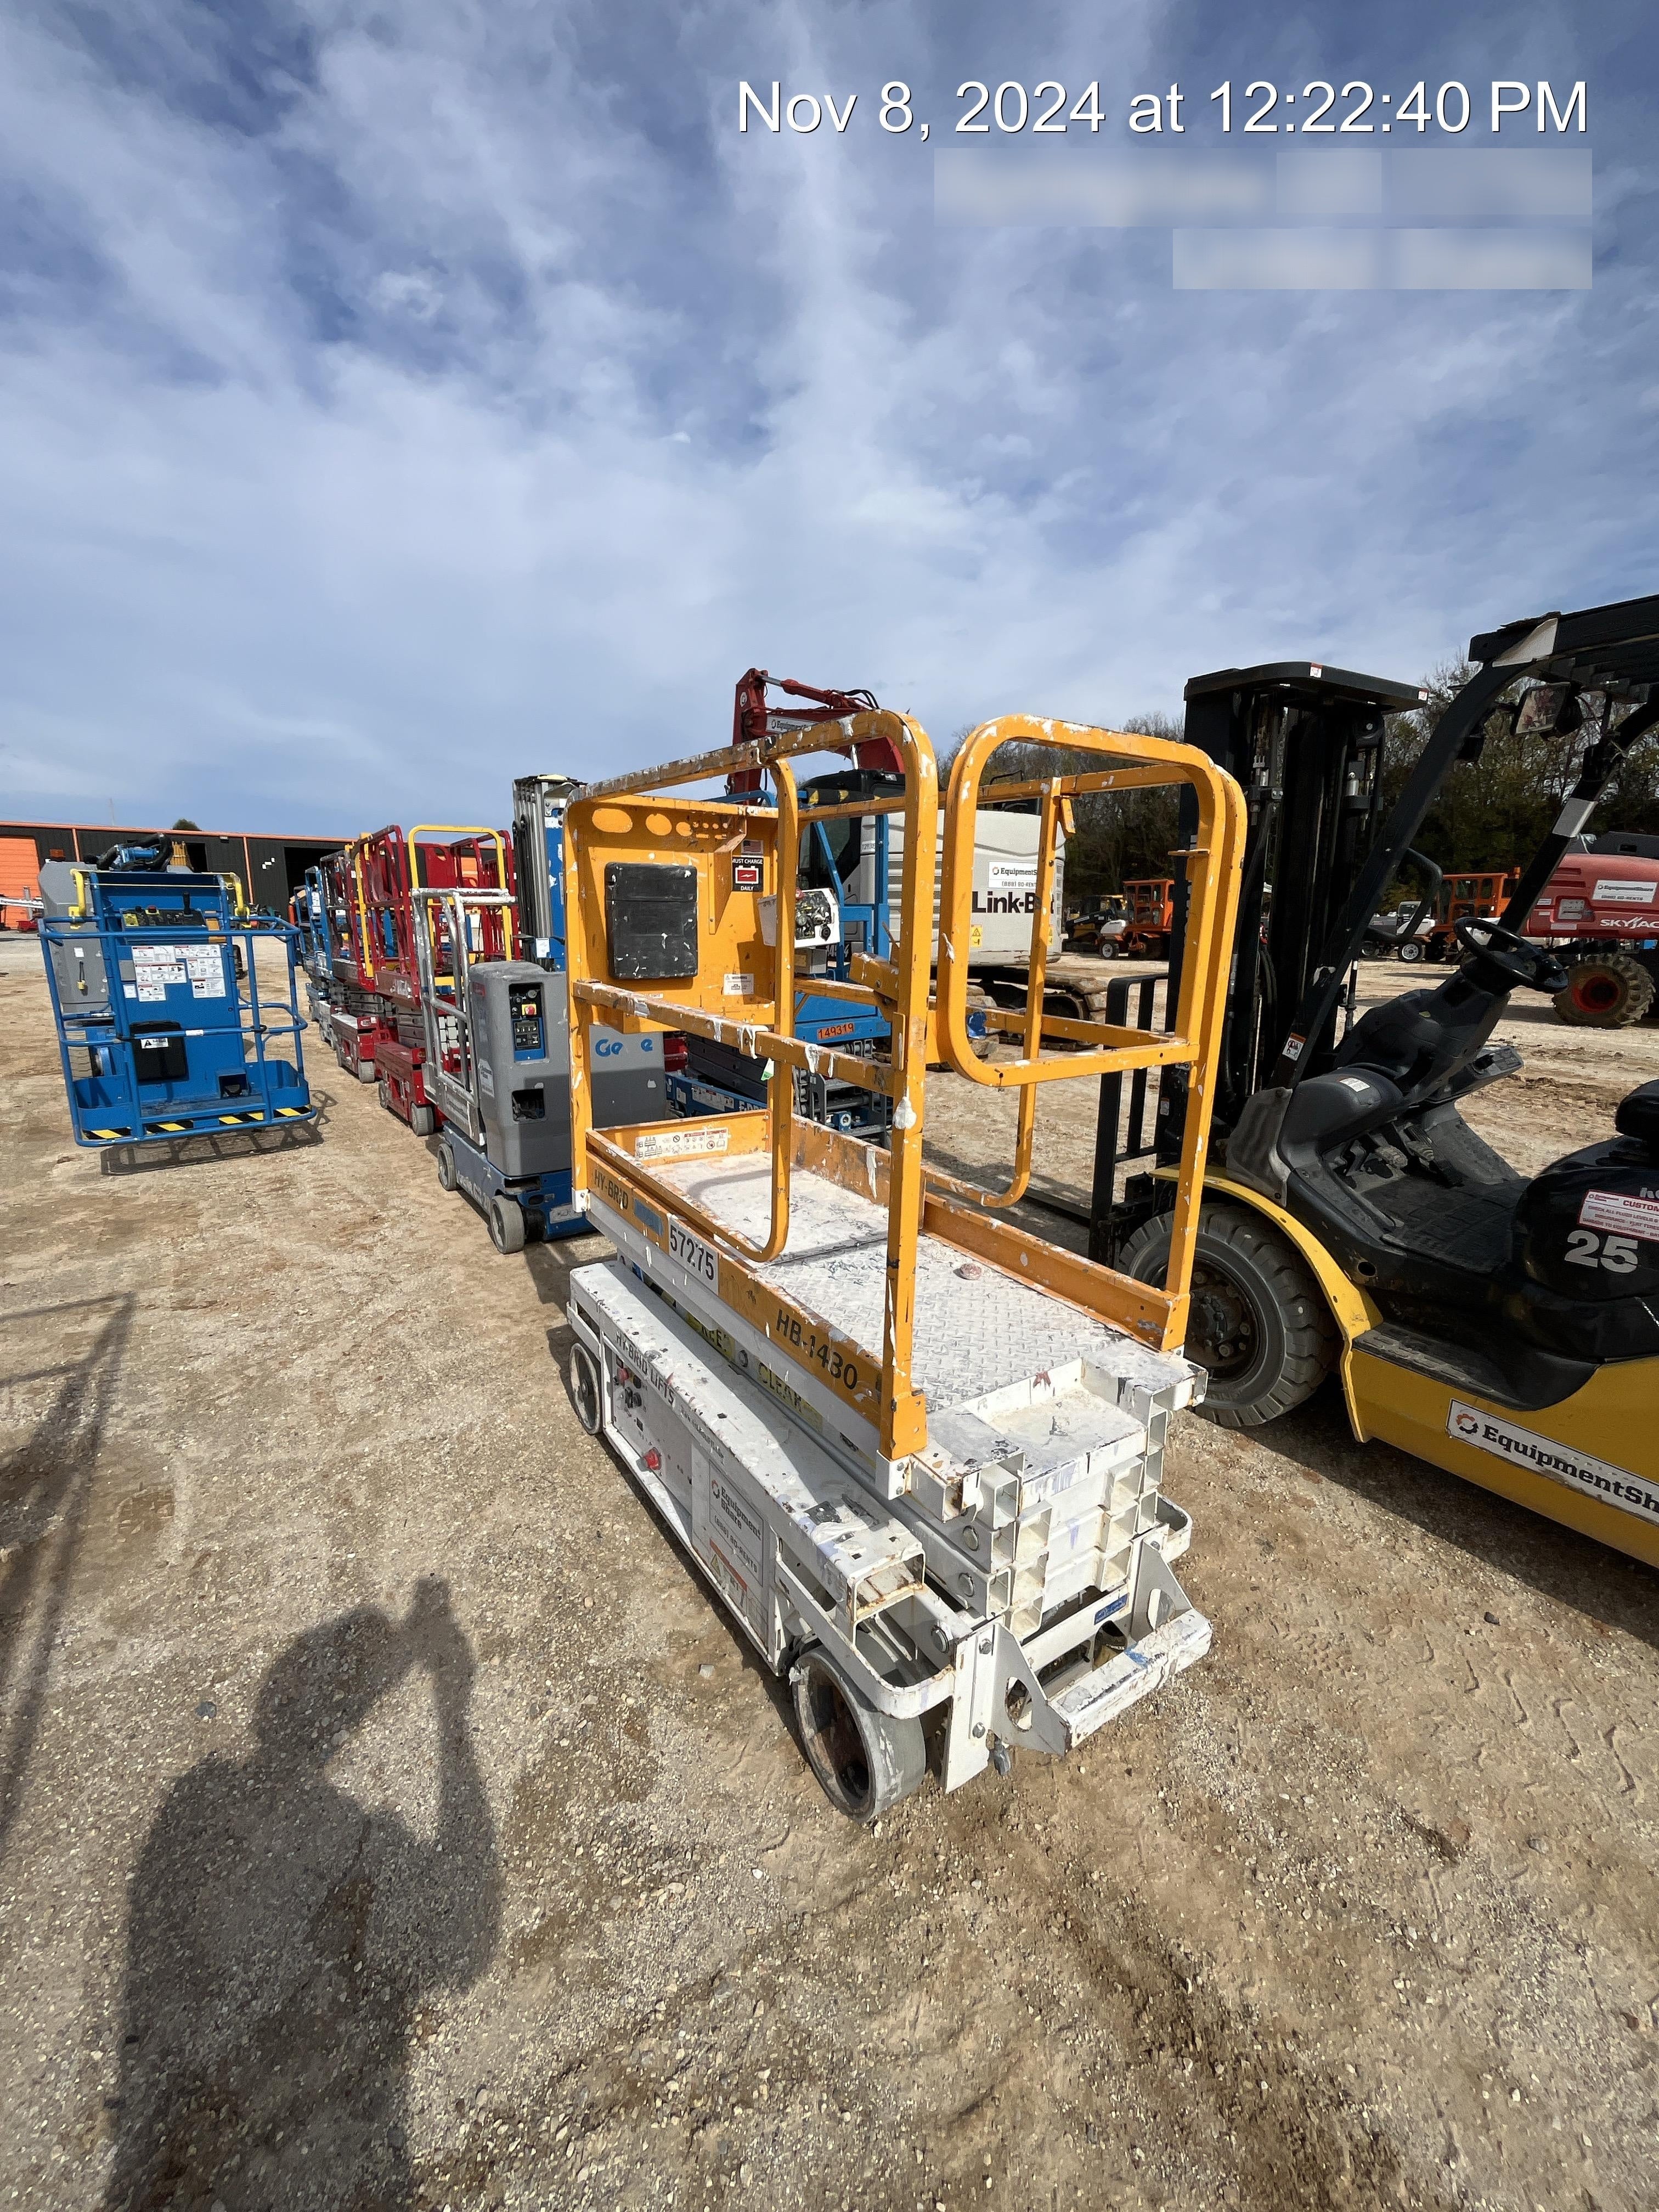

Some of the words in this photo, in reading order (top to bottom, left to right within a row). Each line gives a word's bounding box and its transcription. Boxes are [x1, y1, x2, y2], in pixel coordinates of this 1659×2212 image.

[817, 1023, 854, 1039] 149319
[594, 1169, 628, 1210] HY-BRID
[670, 1224, 714, 1281] 57275
[1564, 1230, 1639, 1273] 25
[776, 1308, 858, 1390] HB-1430
[651, 1367, 675, 1406] LIFTS
[721, 1486, 761, 1541] Equipment
[721, 1498, 742, 1530] Share
